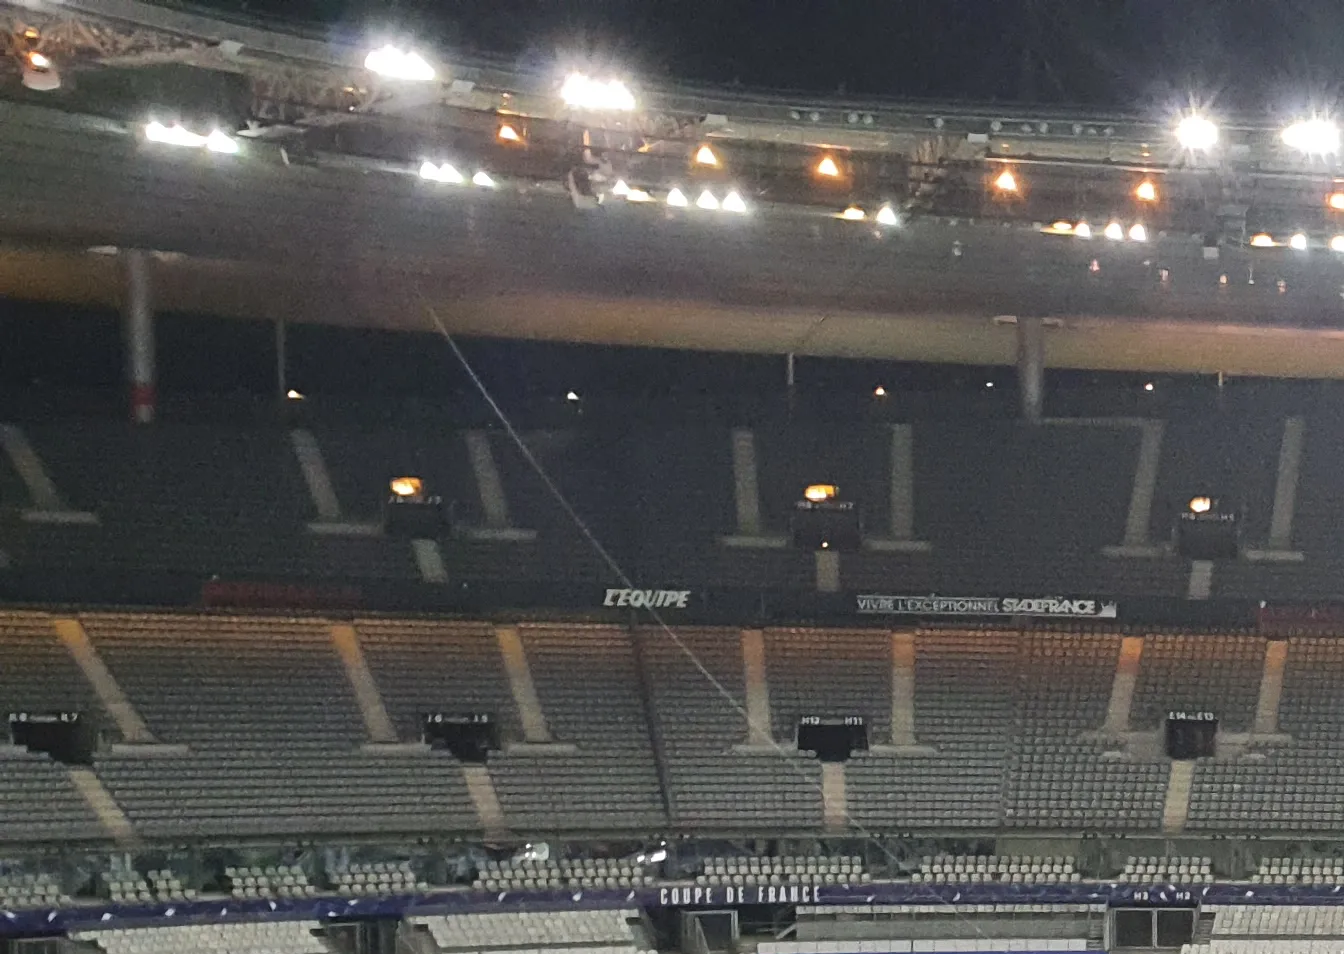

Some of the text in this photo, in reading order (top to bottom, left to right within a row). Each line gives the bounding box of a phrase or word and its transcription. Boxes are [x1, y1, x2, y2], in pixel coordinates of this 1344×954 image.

[661, 885, 820, 905] COUPE DE FRANCE
